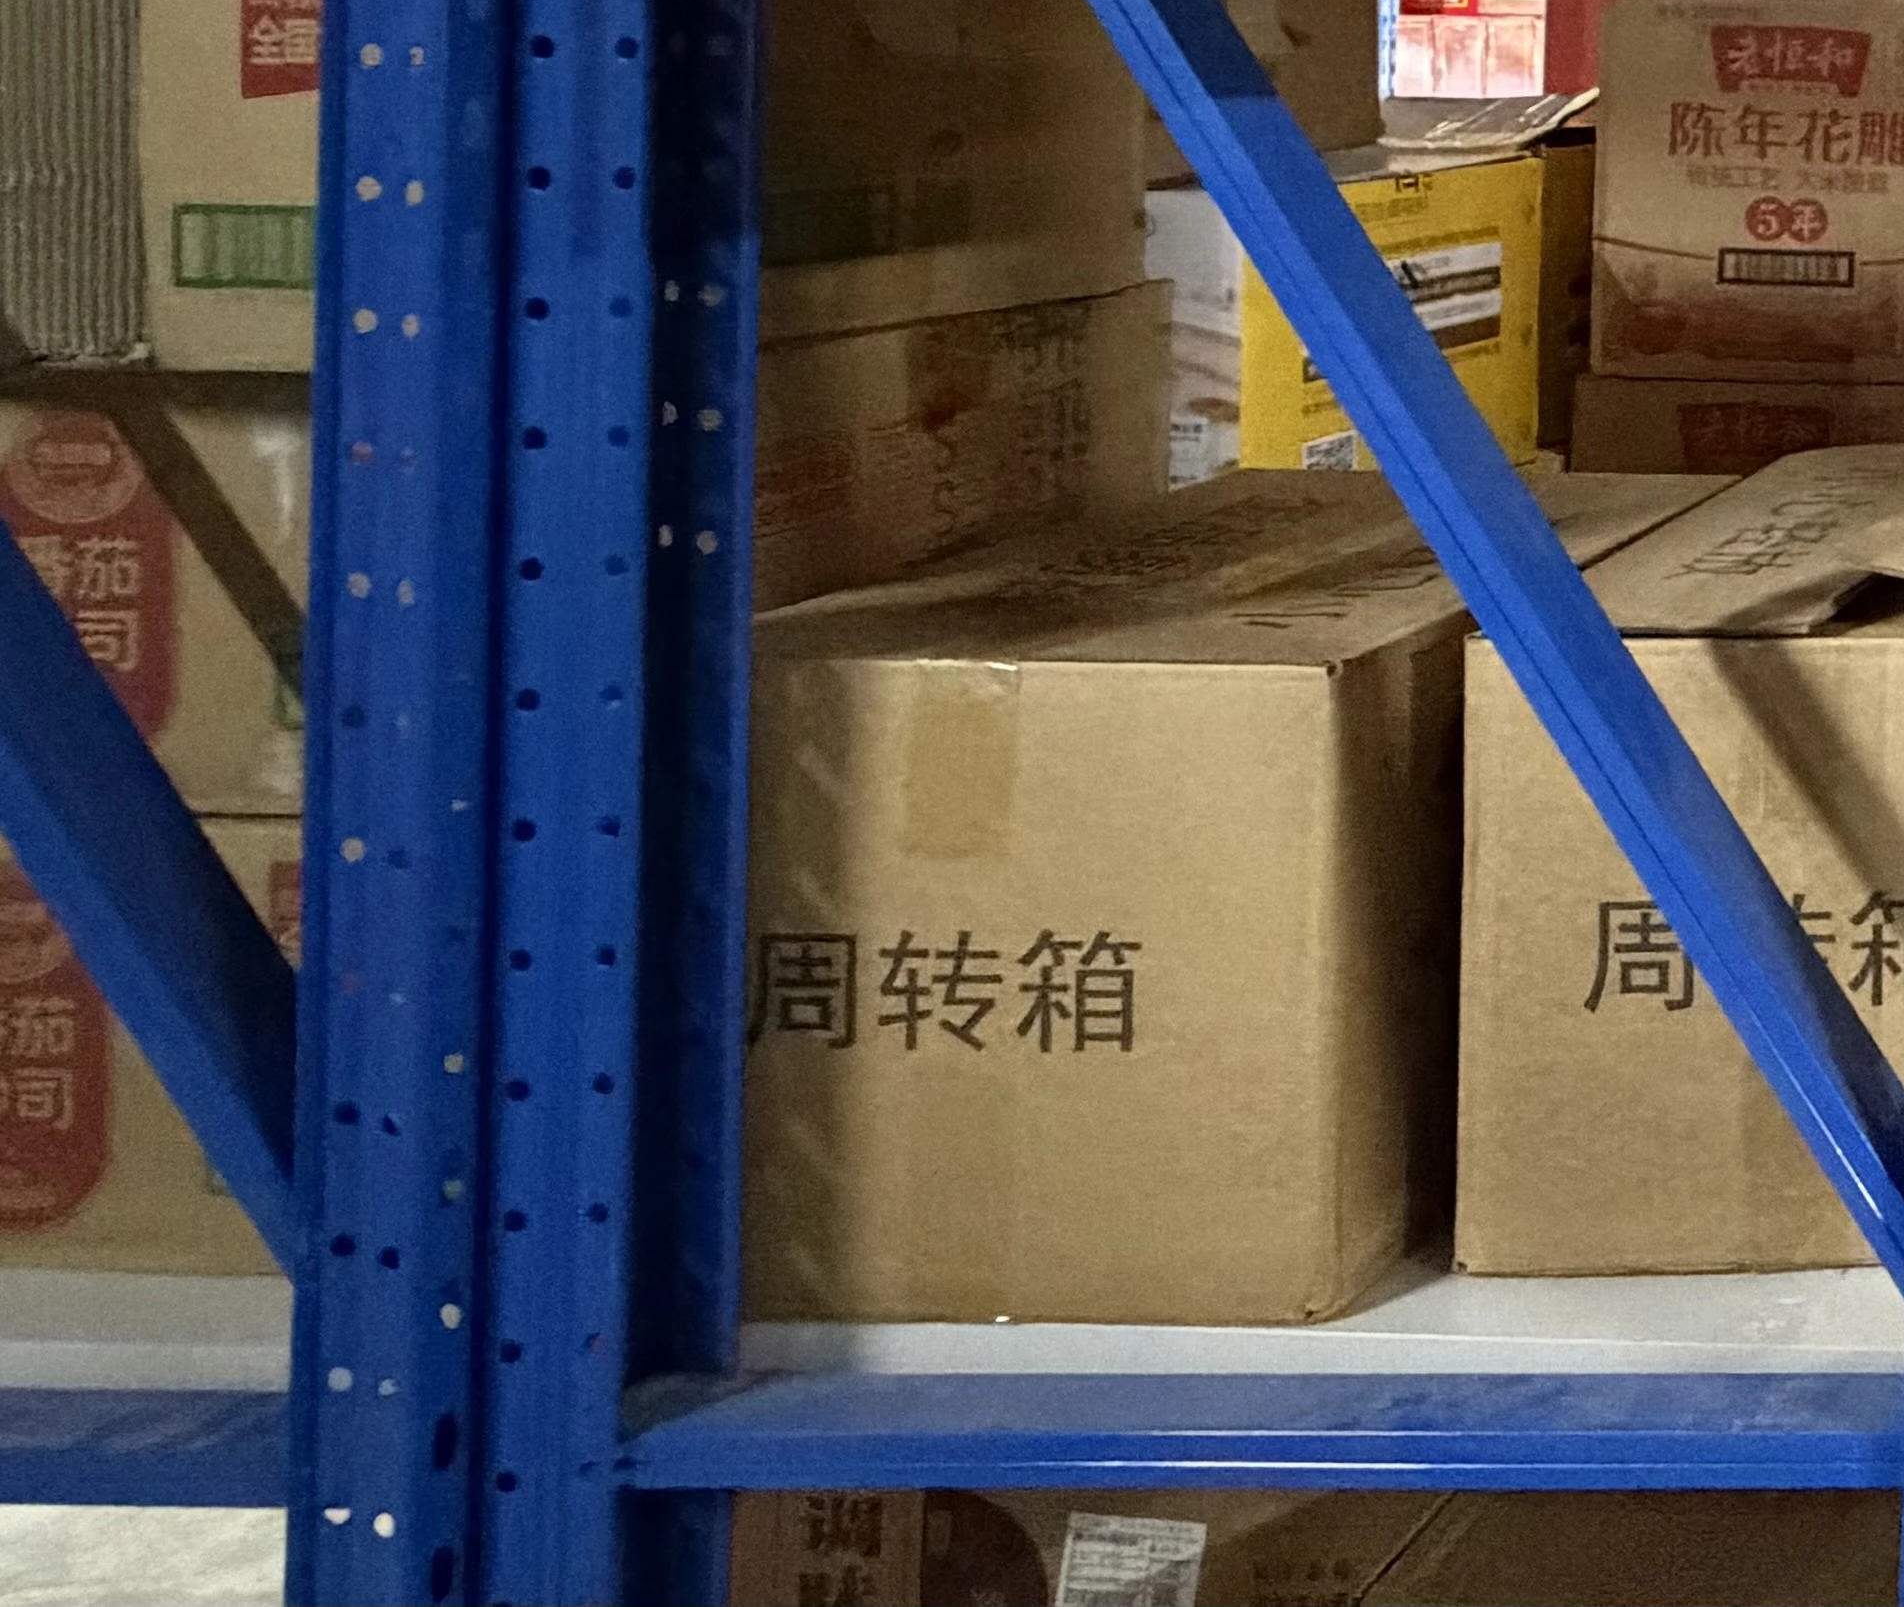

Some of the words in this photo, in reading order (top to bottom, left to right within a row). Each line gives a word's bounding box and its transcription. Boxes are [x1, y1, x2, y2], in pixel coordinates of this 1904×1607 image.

[1751, 198, 1826, 239] 5年
[748, 929, 1143, 1053] 周转箱
